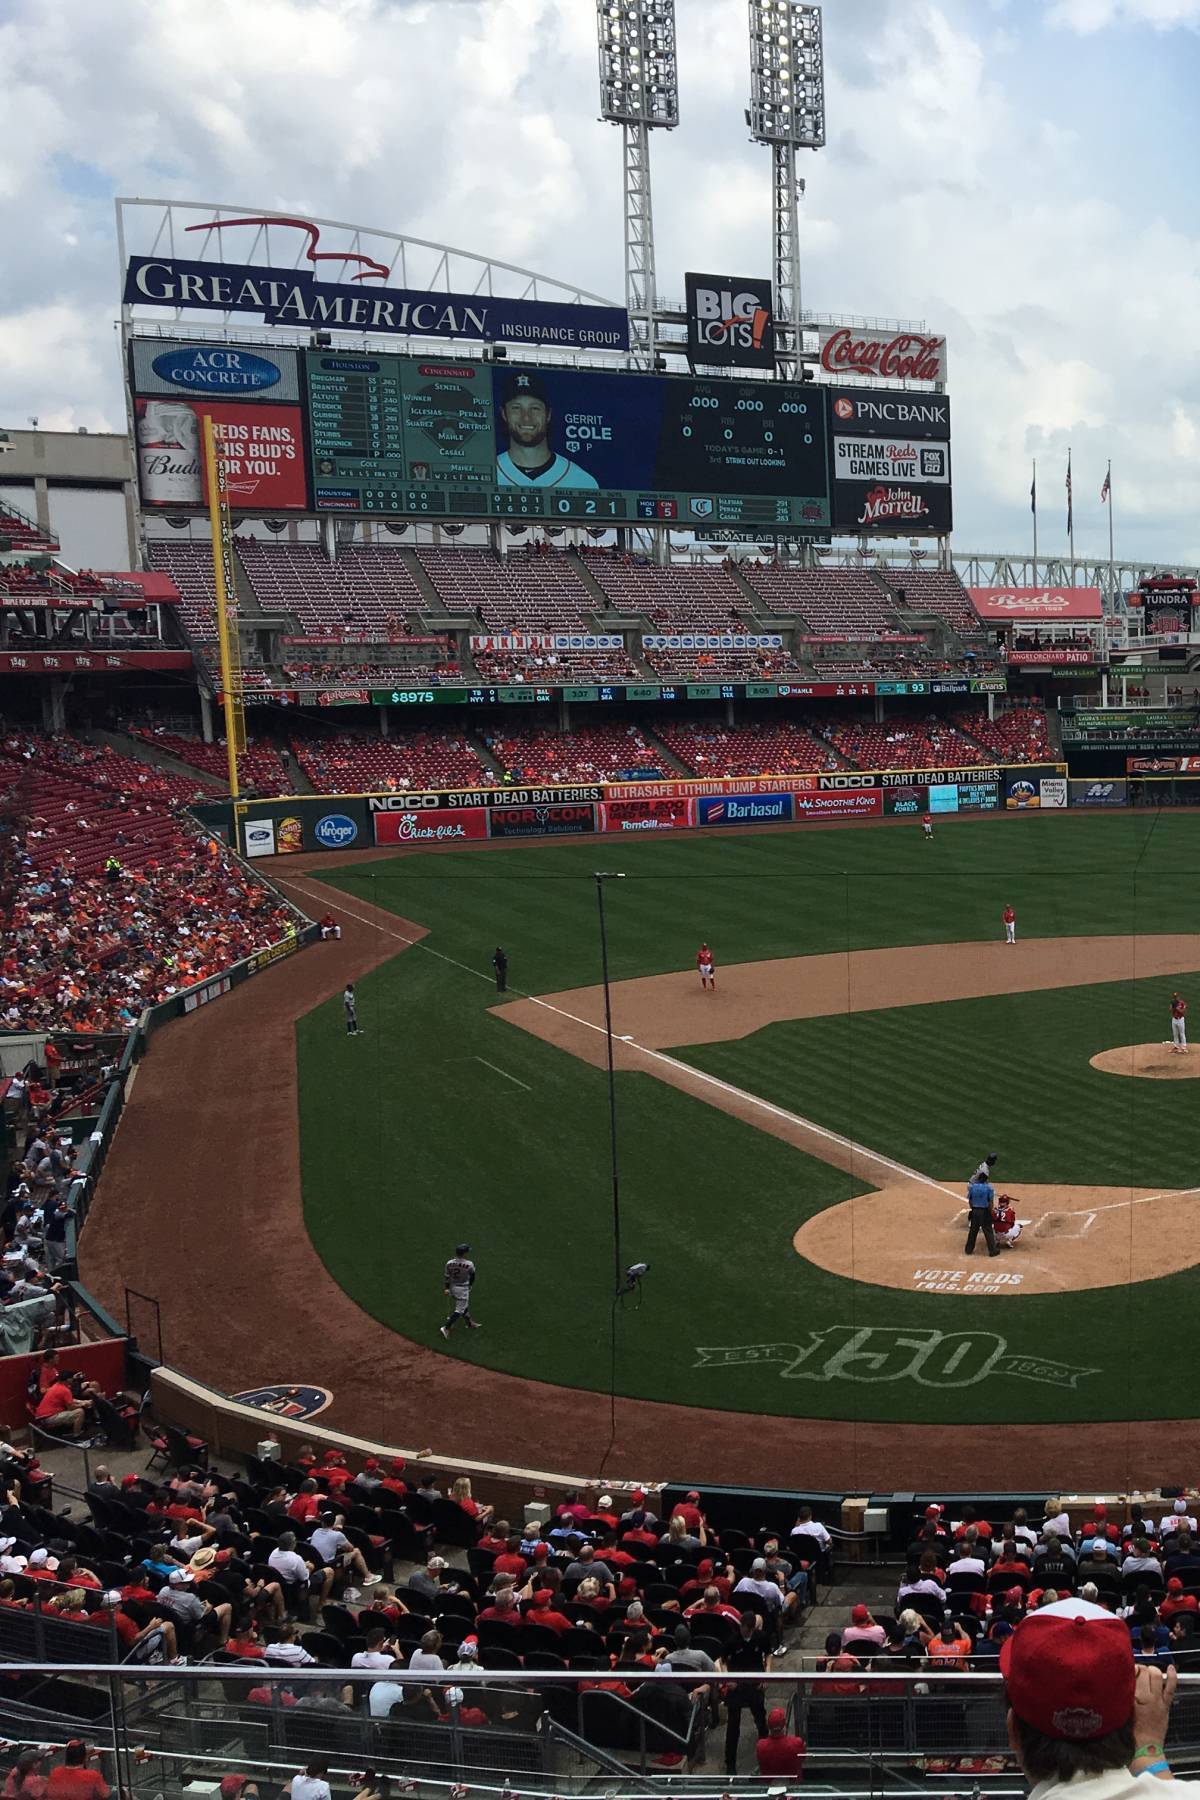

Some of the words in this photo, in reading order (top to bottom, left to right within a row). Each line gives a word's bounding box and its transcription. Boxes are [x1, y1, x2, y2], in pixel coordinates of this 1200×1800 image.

[136, 263, 287, 306] GREAT
[276, 286, 489, 333] AMERICAN
[696, 288, 762, 323] BIG
[501, 324, 575, 340] INSURANCE
[579, 329, 621, 344] GROUP
[192, 352, 243, 369] ACR
[821, 328, 946, 380] Coca-Cola
[332, 361, 371, 370] HOUSTON
[424, 368, 470, 377] CINCINNATI
[171, 369, 262, 386] CONCRETE
[311, 383, 348, 391] BRANTLEY
[312, 392, 340, 400] ALTUVE
[411, 407, 442, 415] IGLESIAS
[688, 396, 719, 409] .000
[734, 399, 764, 412] .000
[778, 402, 808, 414] .000
[856, 401, 895, 420] PNC
[896, 404, 946, 423] BANK
[458, 422, 491, 430] DIETRICH
[564, 413, 603, 425] GERRIT
[252, 426, 296, 444] FANS,
[565, 426, 613, 441] COLE
[682, 426, 692, 437] 0
[724, 428, 733, 440] 0
[764, 431, 773, 442] 0
[804, 433, 813, 444] 0
[249, 444, 296, 459] BUD'S
[315, 448, 334, 456] COLE
[586, 443, 593, 451] P
[838, 443, 885, 459] STREAM
[886, 444, 918, 461] Reds
[725, 456, 746, 465] STRIKE
[746, 457, 759, 465] OUT
[759, 458, 786, 467] LOOKING
[924, 452, 940, 461] FOX
[245, 461, 281, 476] YOU.
[850, 460, 889, 476] GAMES
[892, 463, 916, 477] LIVE
[318, 489, 351, 497] HOUSTON
[884, 487, 911, 501] John
[558, 500, 570, 513] 0
[585, 500, 597, 513] 2
[609, 501, 616, 514] 1
[645, 507, 653, 516] 5
[664, 507, 672, 517] 5
[858, 496, 929, 523] Morrell
[698, 533, 754, 542] ULTIMATE
[755, 534, 774, 542] AIR
[776, 535, 826, 544] SHUTTLE
[987, 592, 1070, 609] Reds
[1145, 595, 1188, 604] TUNDRA
[1066, 653, 1088, 662] PATIO
[911, 684, 925, 693] 93
[941, 684, 968, 693] Ballpark
[980, 682, 1004, 691] Evans
[391, 691, 434, 703] $8975
[820, 775, 875, 789] NOCO
[882, 773, 918, 786] START
[918, 772, 945, 784] DEAD
[949, 771, 1002, 783] BATTERIES.
[1041, 780, 1063, 788] Miami
[608, 785, 674, 799] ULTRASAFE
[678, 782, 723, 796] LITHIUM
[726, 781, 756, 793] JUMP
[758, 777, 816, 792] STARTERS.
[1043, 787, 1065, 796] Valley
[369, 795, 439, 811] NOCO
[448, 793, 489, 807] START
[493, 791, 529, 805] DEAD
[532, 787, 602, 802] BATTERIES.
[815, 797, 855, 807] SMOOTHIE
[855, 796, 876, 806] KING
[727, 801, 783, 818] Barbasol
[320, 821, 352, 842] Kroger
[398, 819, 466, 840] Chick-fil-A
[913, 1270, 968, 1281] VOTE
[967, 1272, 1025, 1285] REDS
[916, 1281, 1000, 1293] reds.com
[724, 1346, 783, 1361] EST.
[781, 1325, 1008, 1388] 150
[1005, 1357, 1070, 1380] 1869
